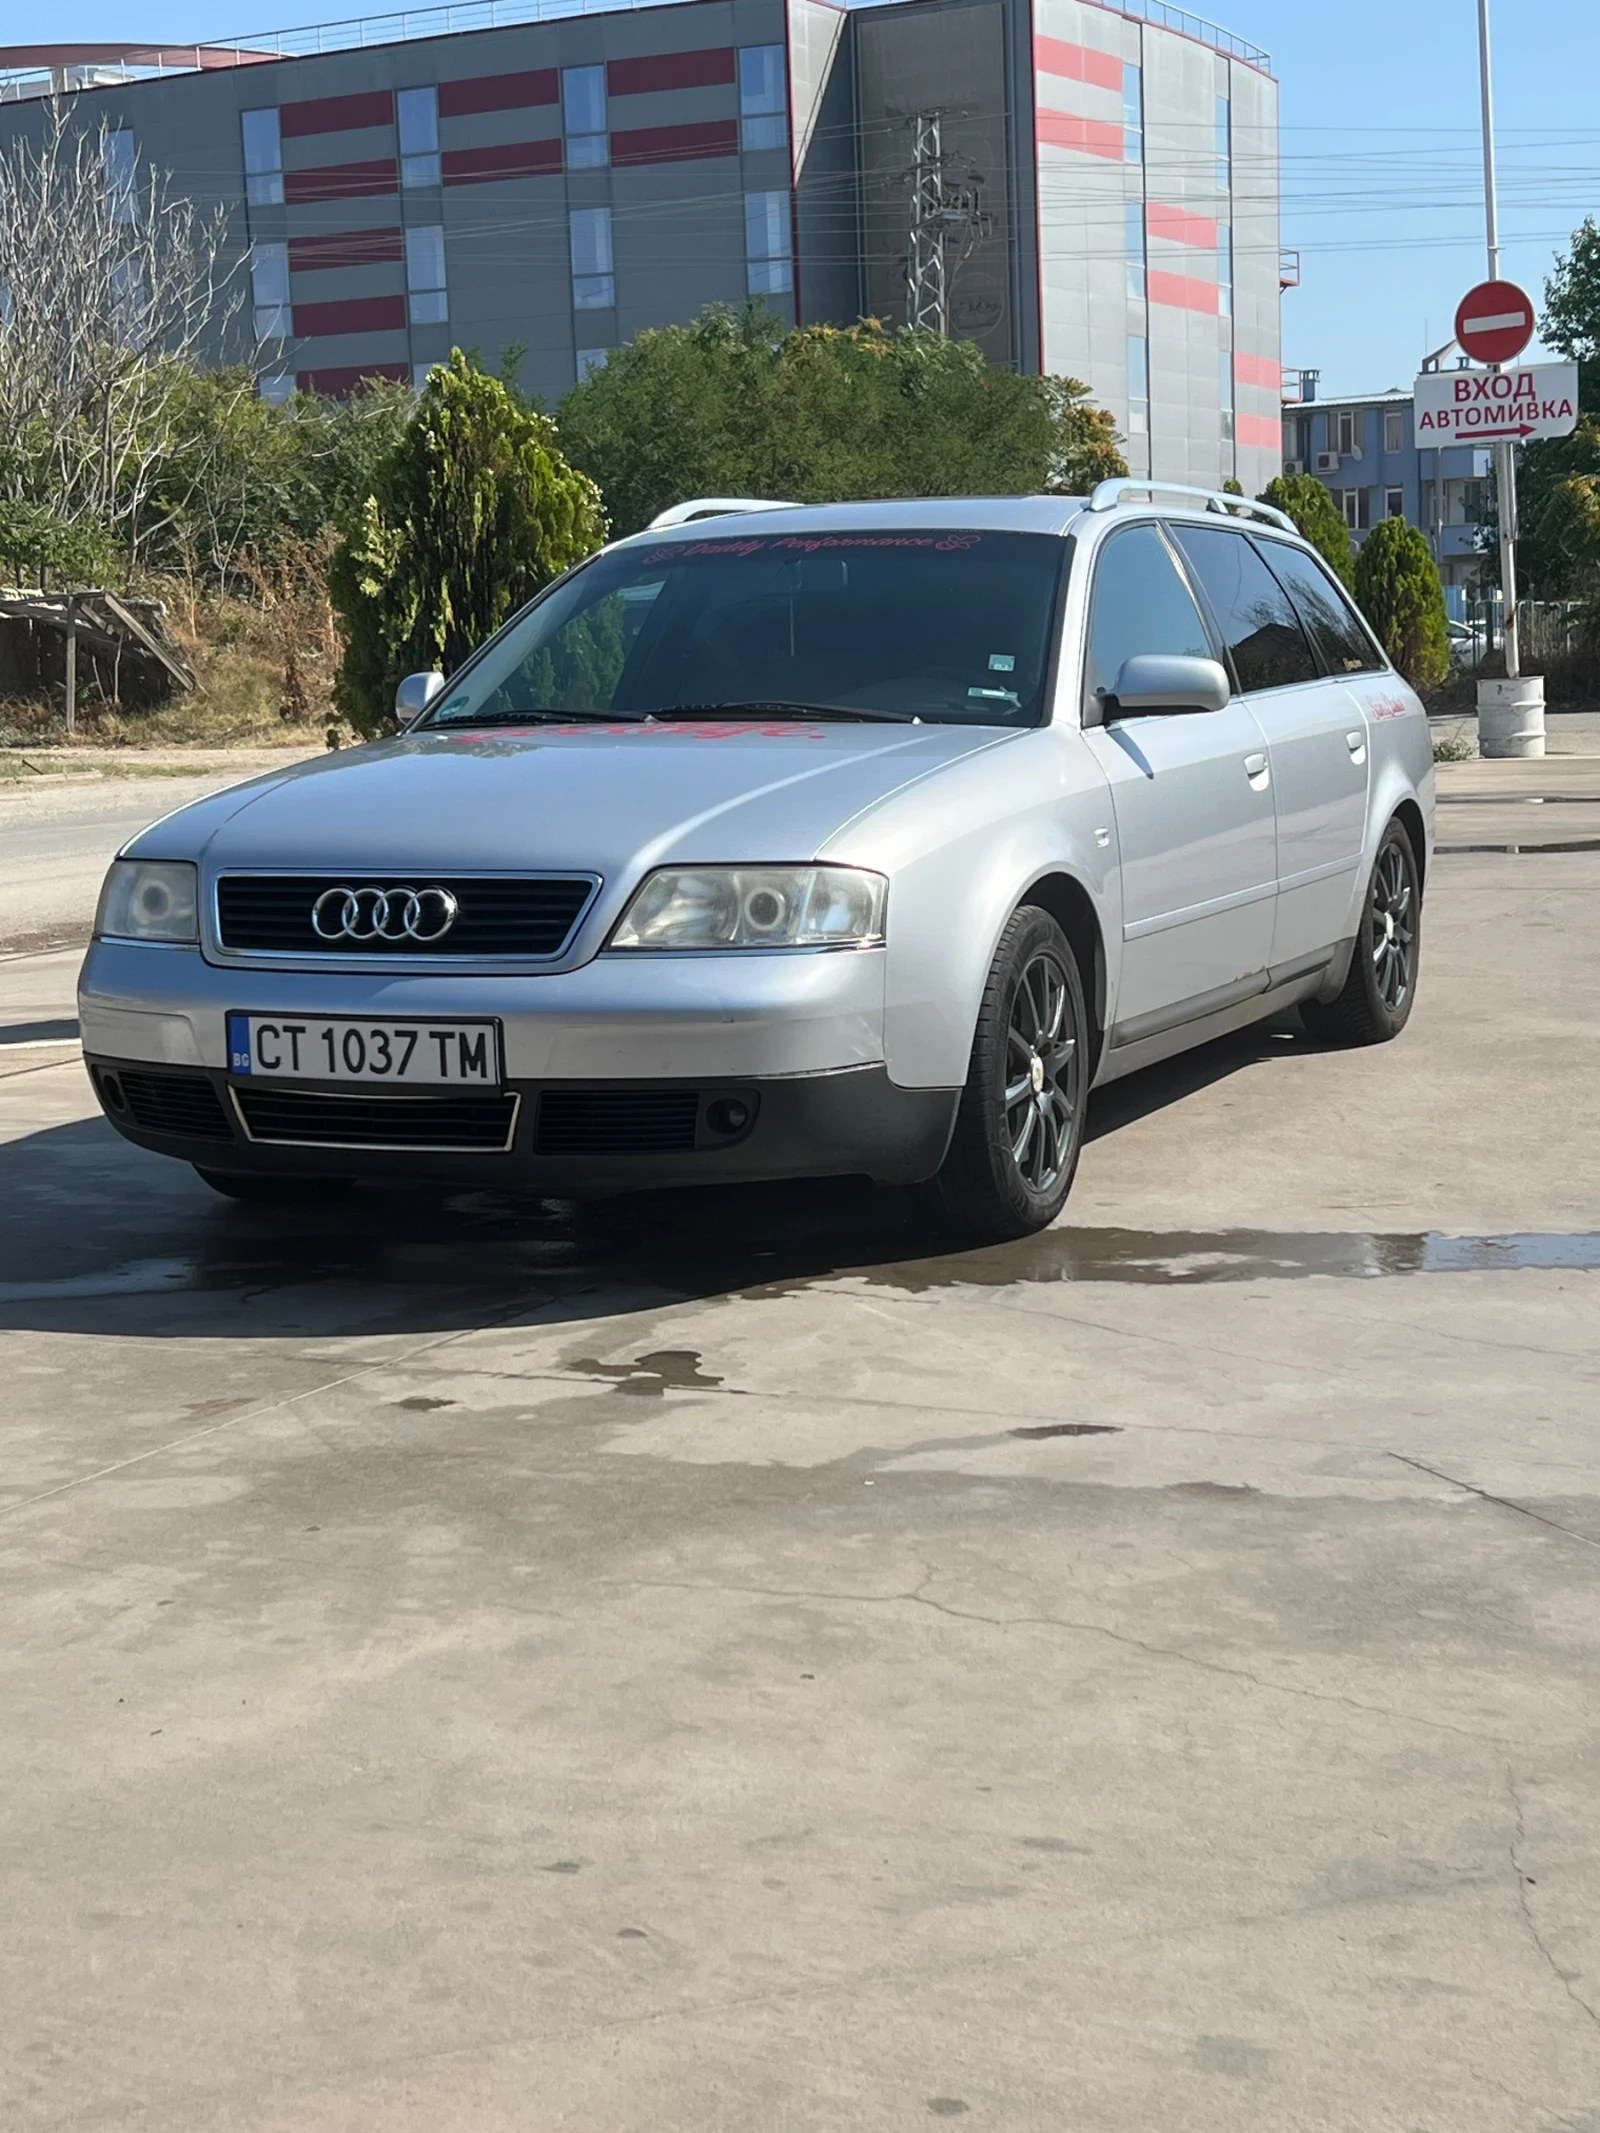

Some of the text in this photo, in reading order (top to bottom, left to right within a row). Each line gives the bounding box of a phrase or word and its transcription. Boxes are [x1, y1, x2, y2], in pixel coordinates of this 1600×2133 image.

[1454, 373, 1536, 403] ВХОД
[1419, 399, 1573, 430] АВТОМИВКА
[771, 537, 933, 552] Performance
[232, 1052, 250, 1067] BG
[256, 1024, 488, 1078] CT 1037 TM
